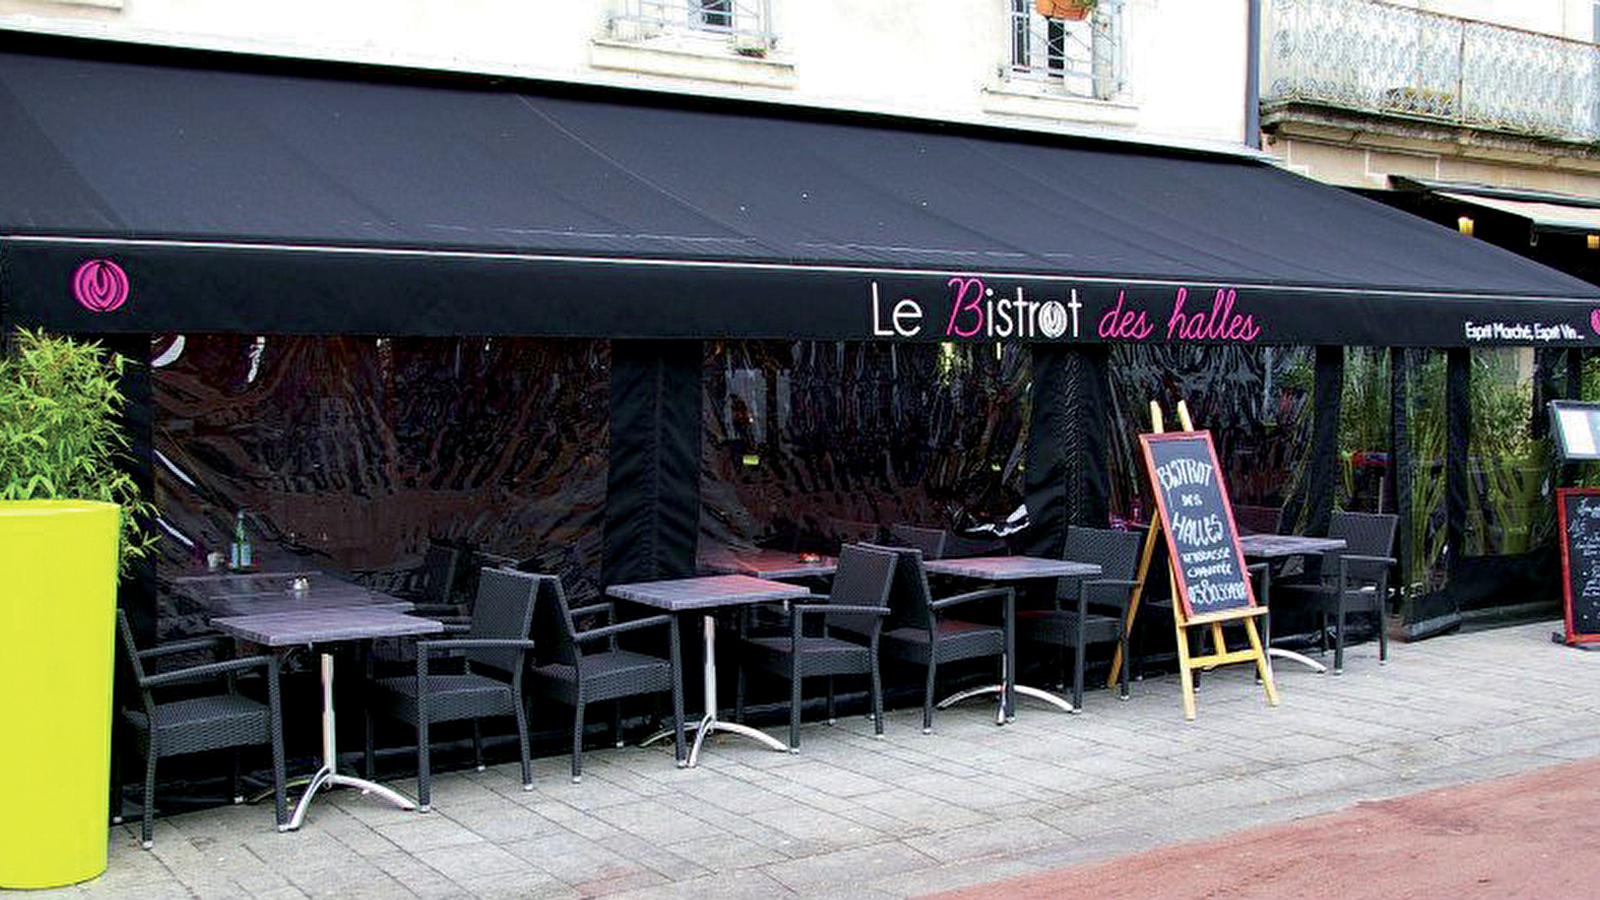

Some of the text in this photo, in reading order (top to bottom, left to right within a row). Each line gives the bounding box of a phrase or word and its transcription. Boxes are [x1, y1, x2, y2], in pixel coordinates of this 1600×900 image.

[872, 278, 1260, 341] Le Bistrot des halles
[1465, 321, 1492, 341] Esprit
[1156, 458, 1212, 491] BISTROT
[1181, 493, 1203, 507] DES
[1172, 511, 1224, 547] HALLES
